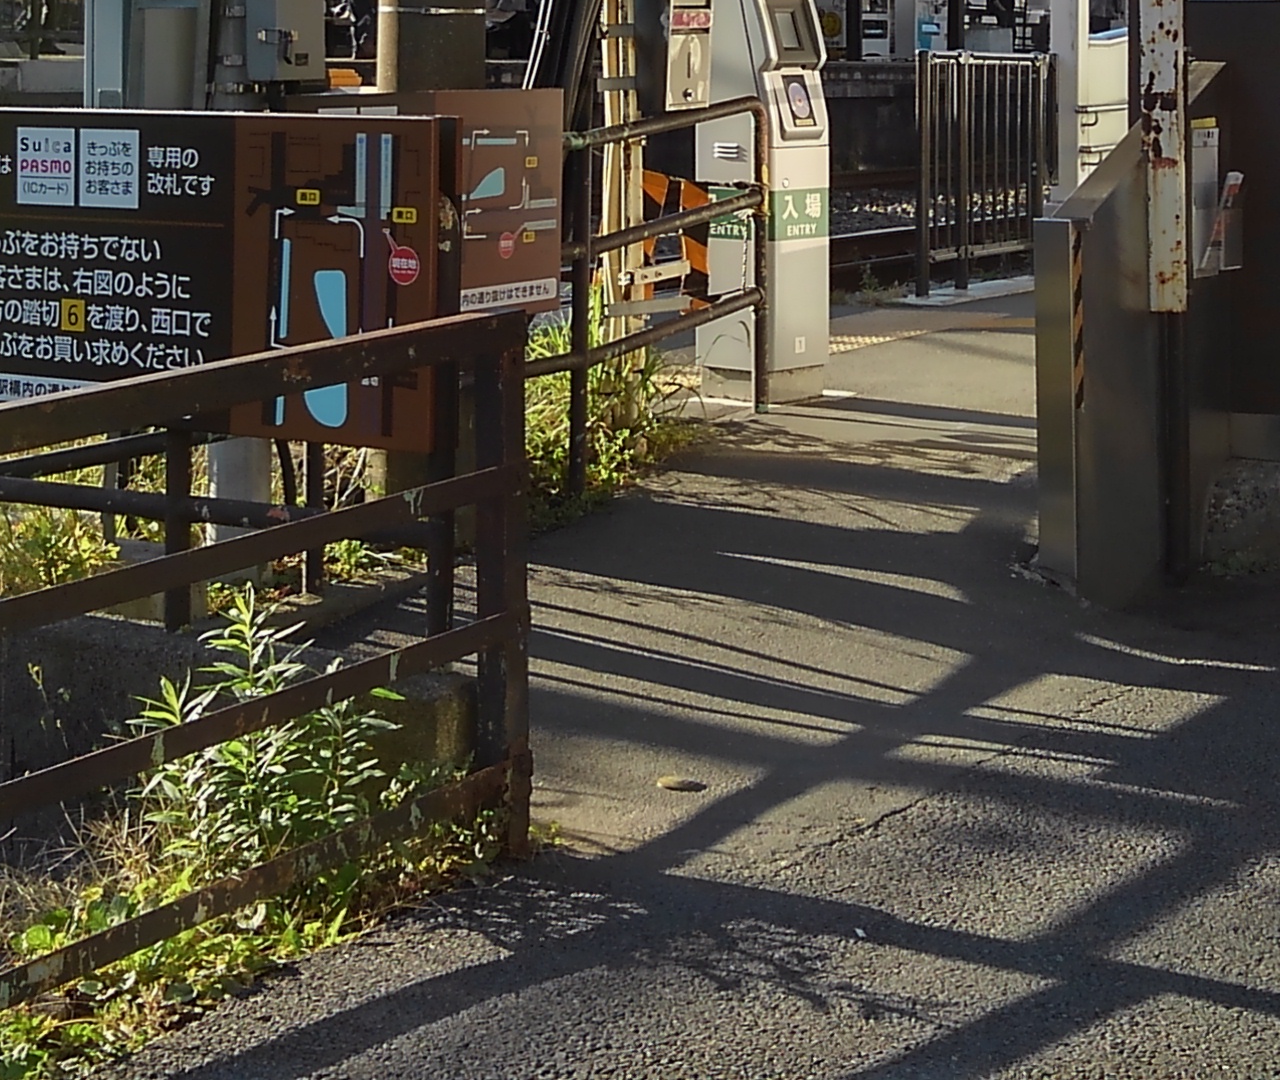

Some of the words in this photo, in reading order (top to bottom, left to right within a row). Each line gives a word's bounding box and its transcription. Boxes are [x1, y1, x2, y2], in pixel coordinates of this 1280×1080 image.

[20, 137, 72, 152] Suica
[86, 141, 132, 157] きっぷを
[147, 146, 199, 170] 専用の
[20, 159, 71, 174] PASMO
[85, 161, 134, 176] お持ちの
[85, 179, 133, 195] お客さま
[147, 173, 216, 196] 改札です
[782, 193, 822, 220] 入場
[709, 223, 747, 236] ENTRY
[787, 223, 817, 236] ENTRY
